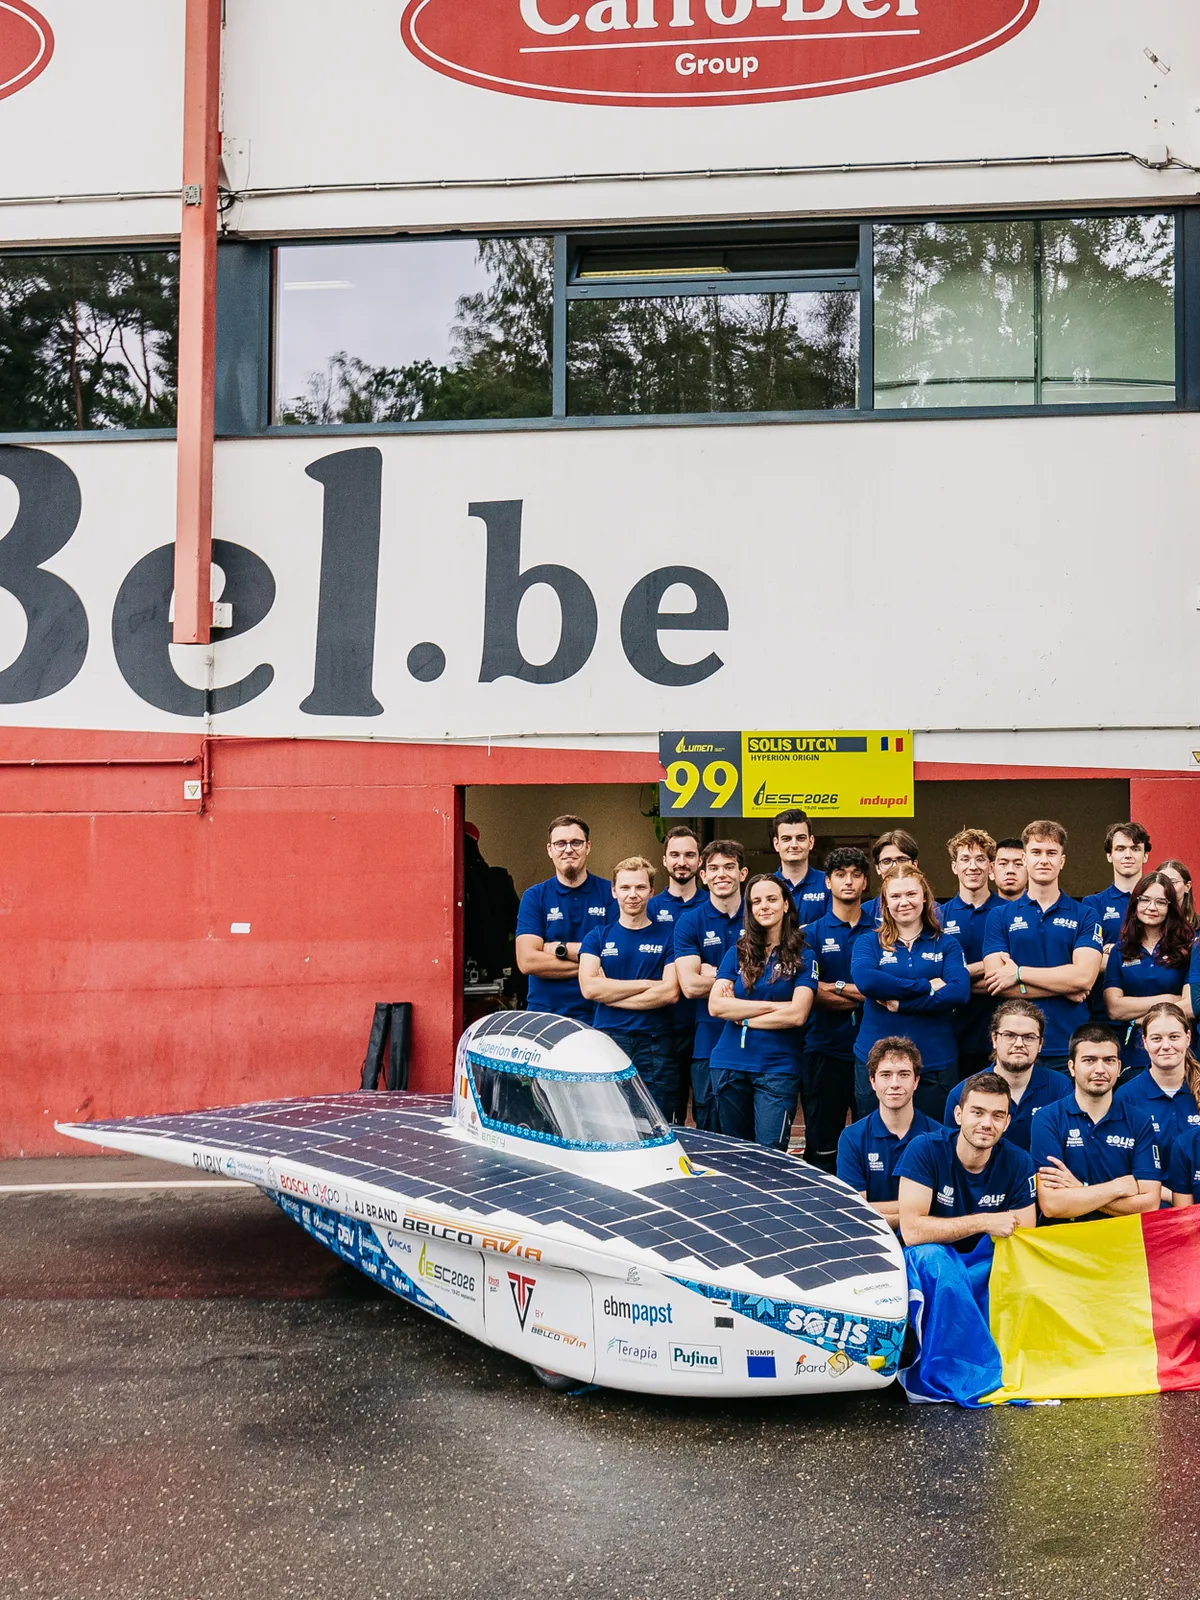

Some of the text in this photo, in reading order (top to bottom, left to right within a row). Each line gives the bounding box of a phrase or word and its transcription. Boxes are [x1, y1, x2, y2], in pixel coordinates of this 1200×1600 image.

[519, 0, 922, 35] Carro-
[675, 53, 759, 78] Group
[749, 738, 837, 752] SOLIS UTCN
[663, 760, 739, 809] 99
[860, 795, 909, 808] indupol
[802, 892, 825, 902] SOLIS
[588, 906, 606, 916] SOLI
[1052, 918, 1078, 931] SOLIS
[638, 943, 663, 954] SOLIS
[477, 1037, 541, 1065] Hyperion Origin
[1105, 1135, 1136, 1148] SOLIS
[280, 1175, 310, 1196] BOSCH
[354, 1201, 397, 1223] AJ BRAND
[482, 1238, 542, 1261] AVIA
[535, 1309, 545, 1318] BY
[604, 1295, 673, 1326] ebmpapst
[785, 1308, 869, 1345] SOLIS
[562, 1336, 587, 1349] AVIA
[615, 1339, 657, 1360] Terapia
[674, 1347, 718, 1367] Pufina
